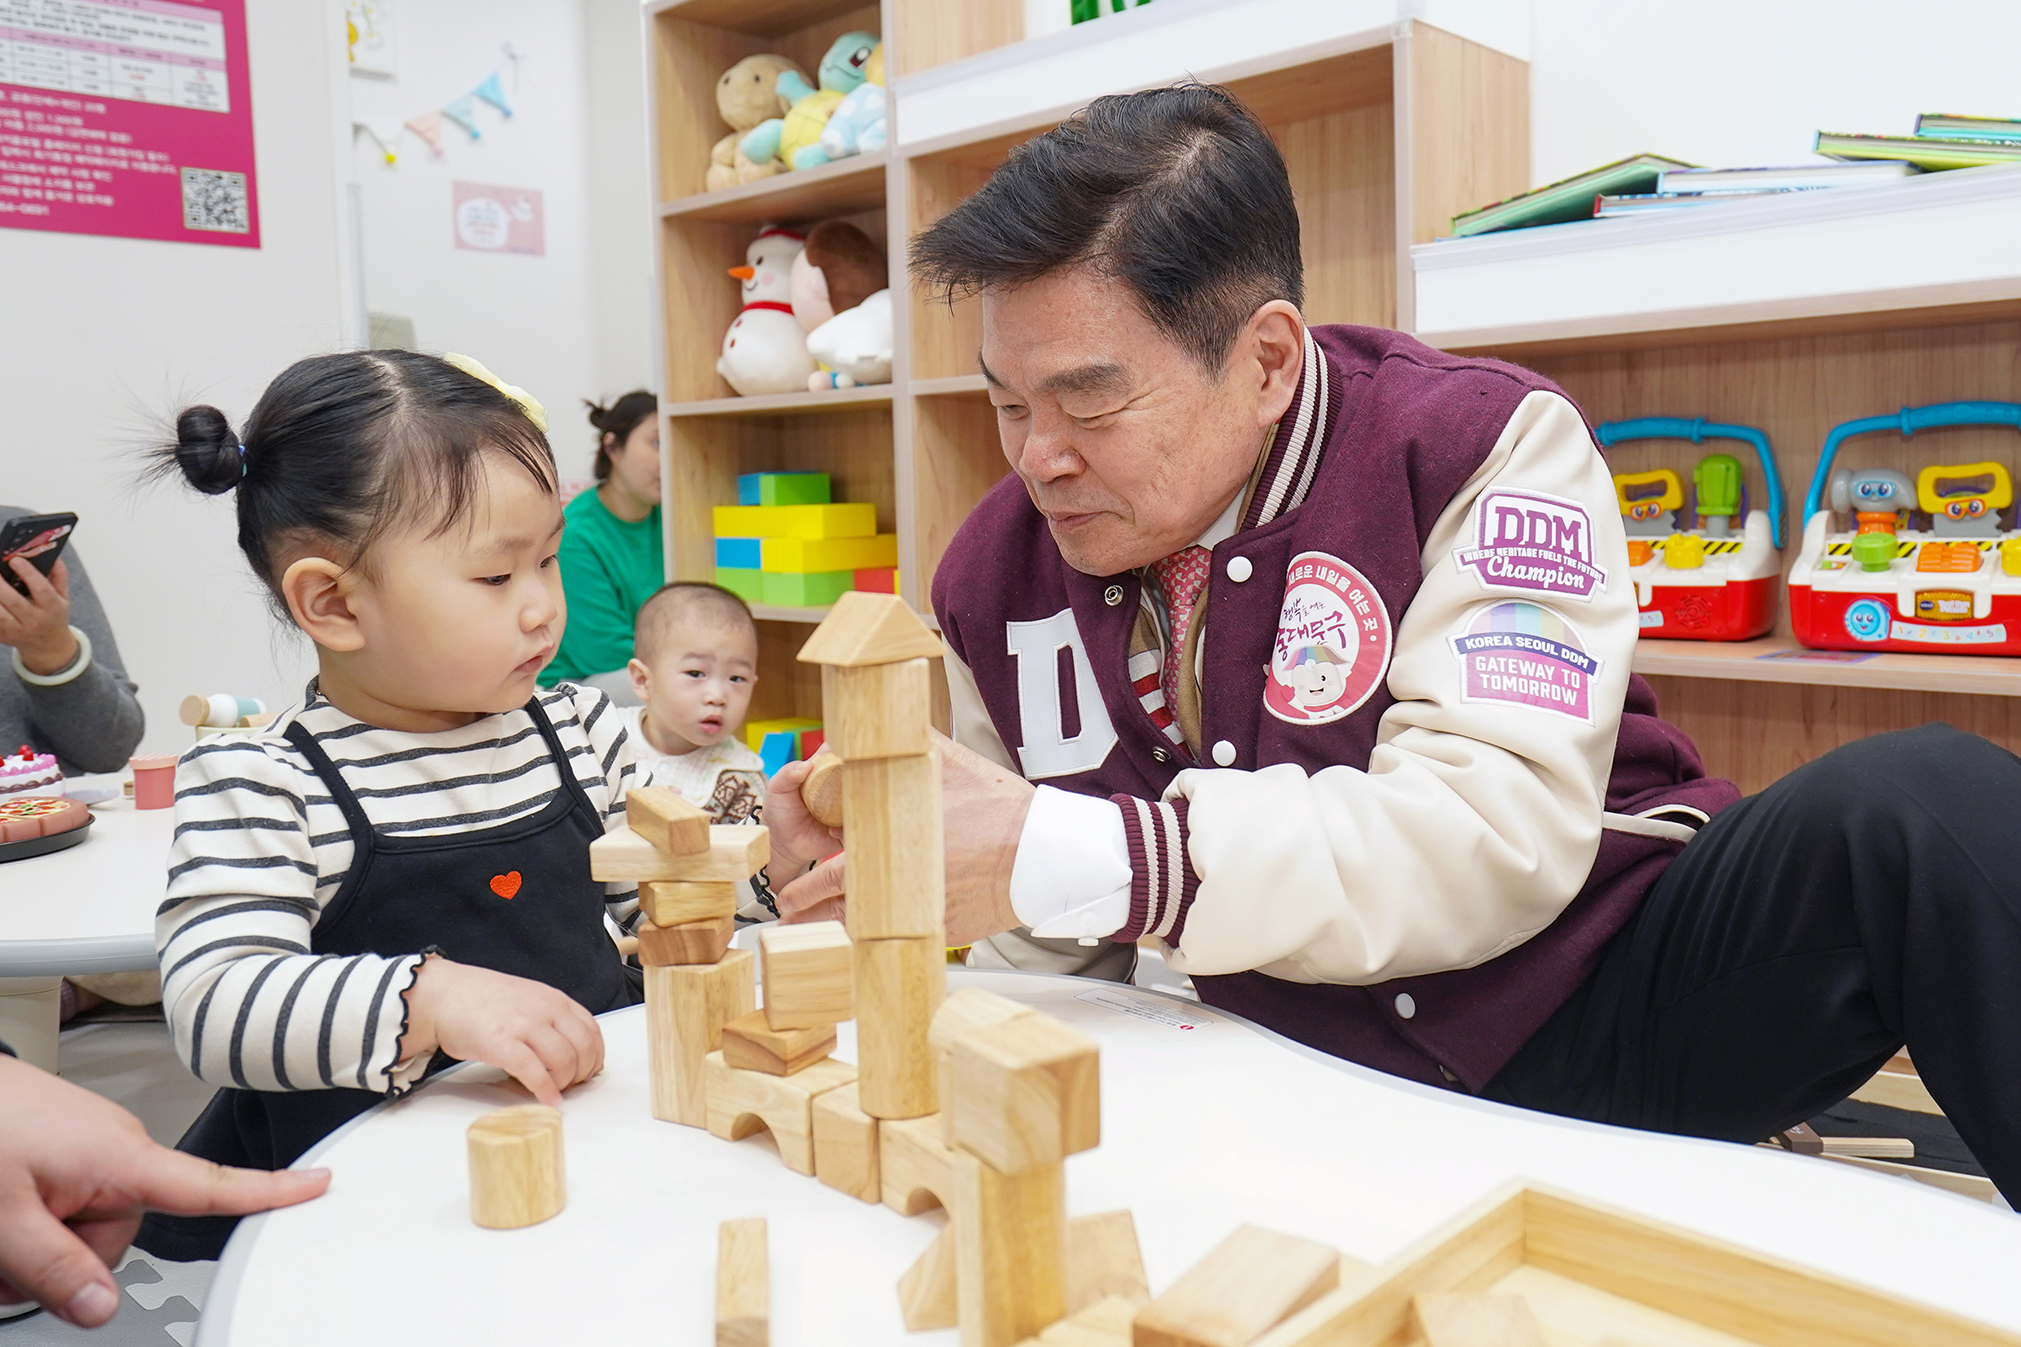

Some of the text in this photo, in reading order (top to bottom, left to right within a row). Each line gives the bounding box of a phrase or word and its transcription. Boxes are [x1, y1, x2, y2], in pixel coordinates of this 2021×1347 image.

[1493, 506, 1582, 560] DDM
[1462, 547, 1604, 584] WHERE HERITAGE FUELS THE FUTURE
[1487, 556, 1585, 589] Champion
[1315, 565, 1351, 593] 내일을
[1348, 589, 1371, 616] 여는
[1363, 617, 1379, 631] 곳
[1276, 610, 1347, 661] 동대문구
[1918, 628, 1927, 638] 2
[1942, 630, 1950, 640] 3
[1987, 628, 1994, 639] 5
[1464, 636, 1589, 669] KOREA SEOUL DDM
[1476, 656, 1581, 689] GATEWAY TO
[1480, 674, 1577, 706] TOMORROW
[1006, 607, 1119, 780] D
